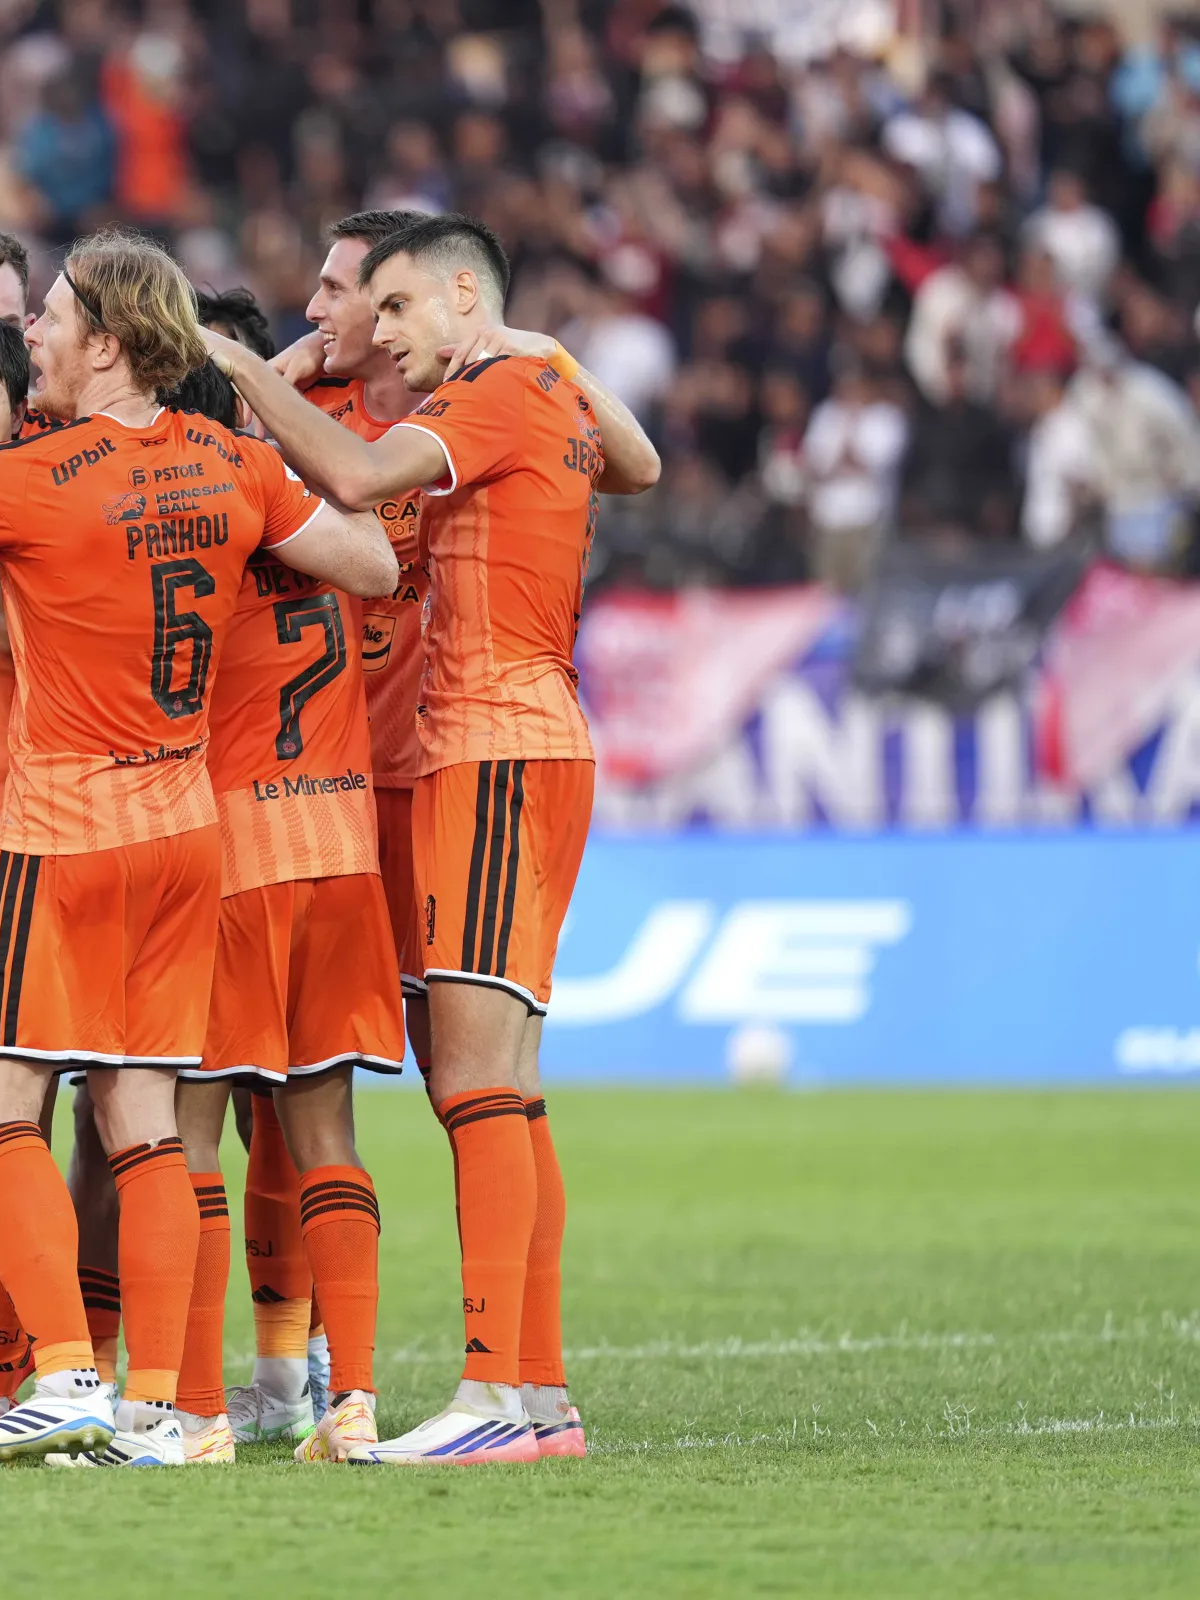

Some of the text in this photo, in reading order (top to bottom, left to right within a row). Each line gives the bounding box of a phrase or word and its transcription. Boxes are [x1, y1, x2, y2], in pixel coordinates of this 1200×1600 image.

[154, 462, 205, 483] PSTORE
[156, 482, 235, 503] HONGSAM
[157, 500, 201, 516] BALL
[150, 557, 216, 720] 6
[272, 591, 347, 761] 7
[252, 768, 367, 802] Le Minerale
[463, 1297, 485, 1314] SJ
